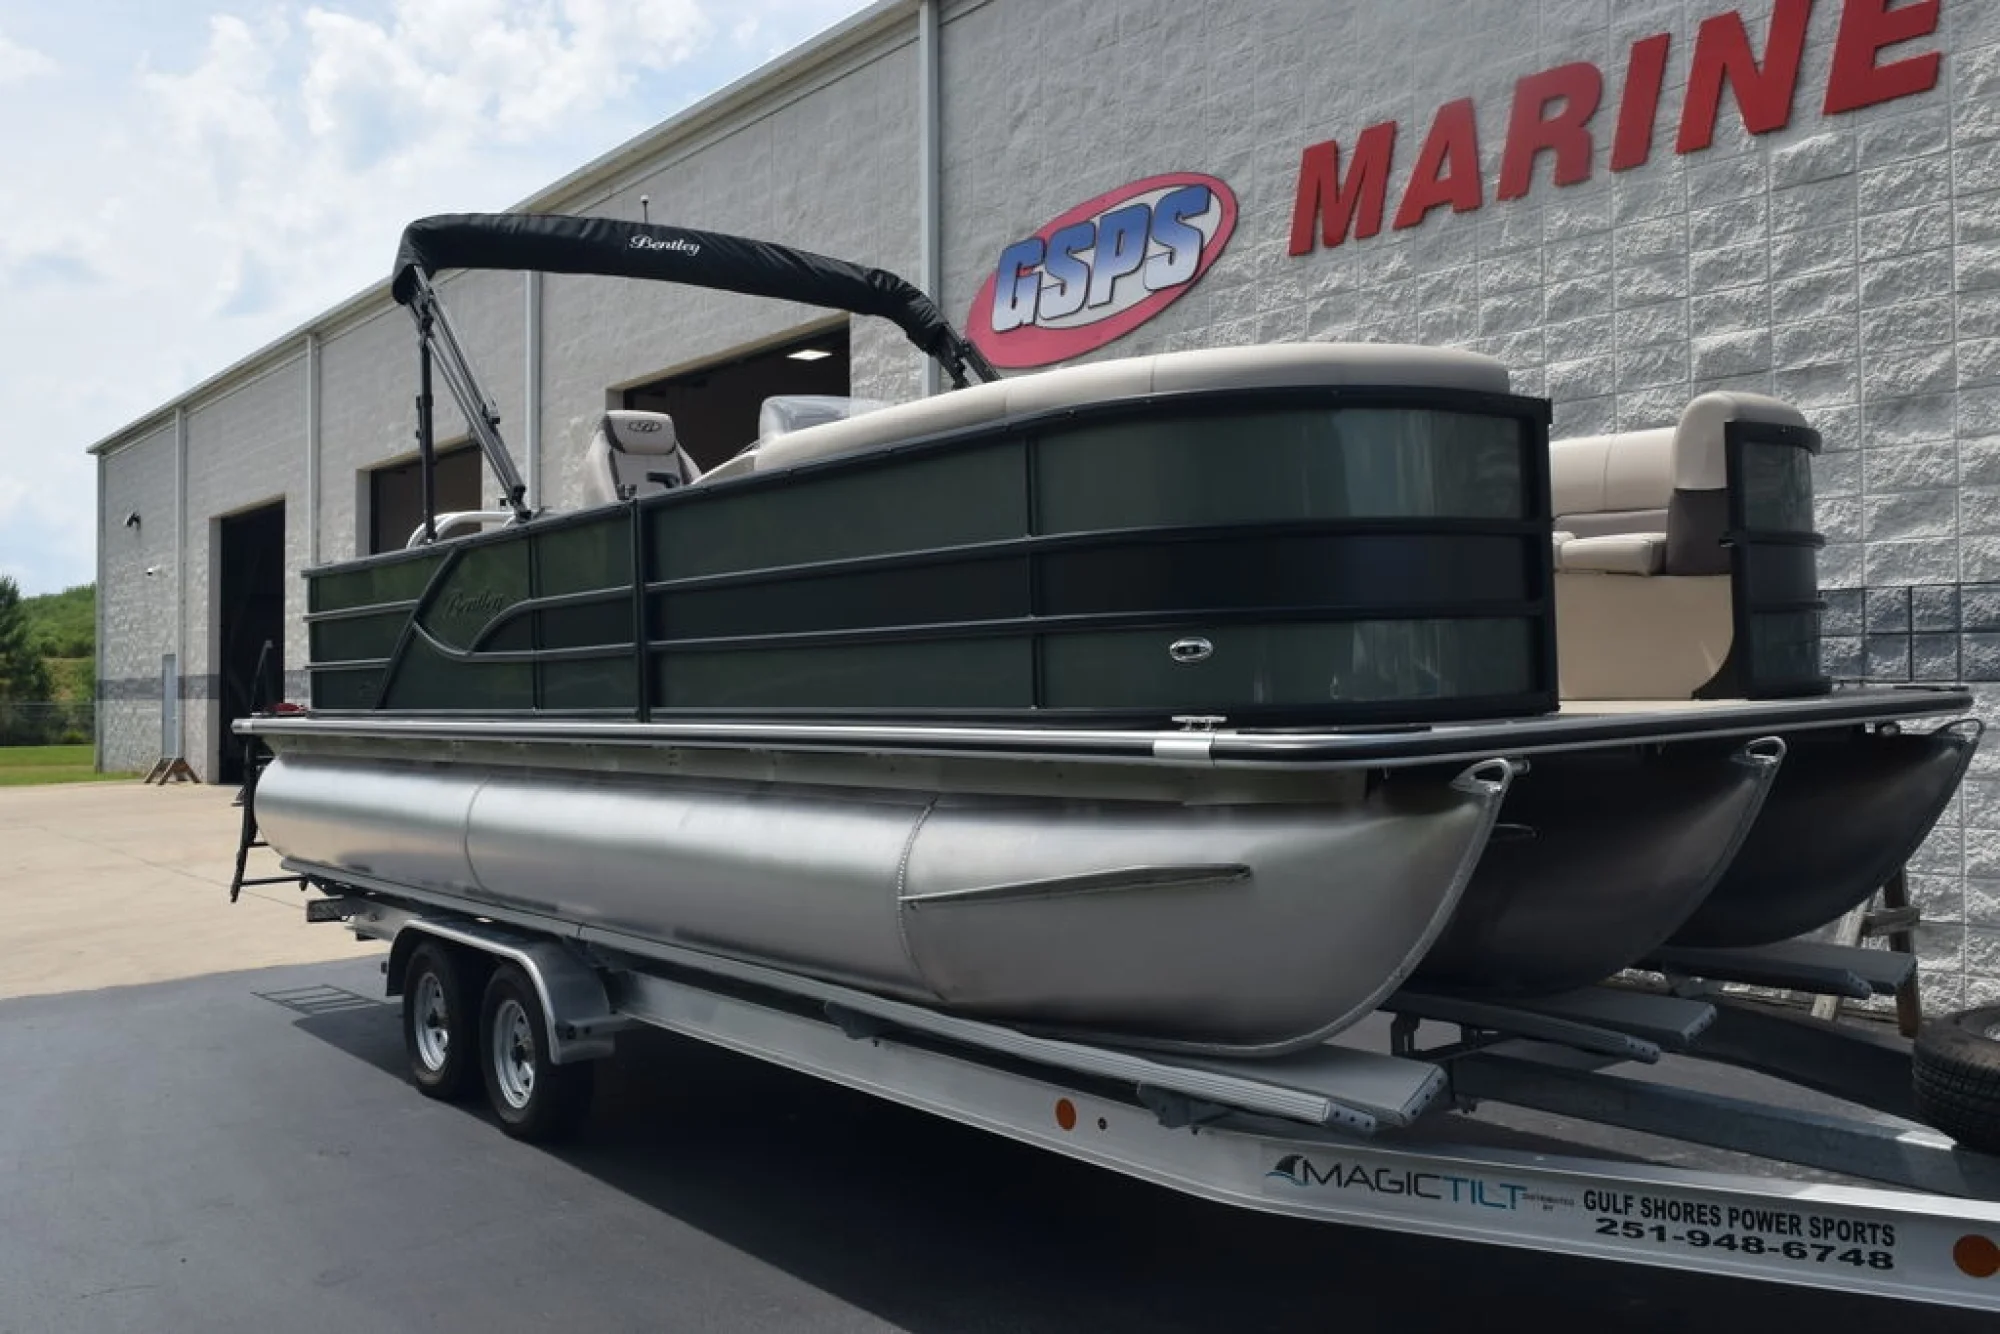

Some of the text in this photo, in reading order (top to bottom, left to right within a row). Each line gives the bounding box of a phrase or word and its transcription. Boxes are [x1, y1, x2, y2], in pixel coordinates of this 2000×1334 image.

[1289, 0, 1942, 257] MARINE
[629, 234, 700, 257] Bentley
[991, 184, 1211, 334] GSPS
[1583, 1189, 1634, 1216] GULF
[1640, 1198, 1722, 1228] SHORES
[1727, 1206, 1802, 1237] POWER
[1808, 1216, 1896, 1247] SPORTS
[1595, 1218, 1894, 1271] 251-948-6748
